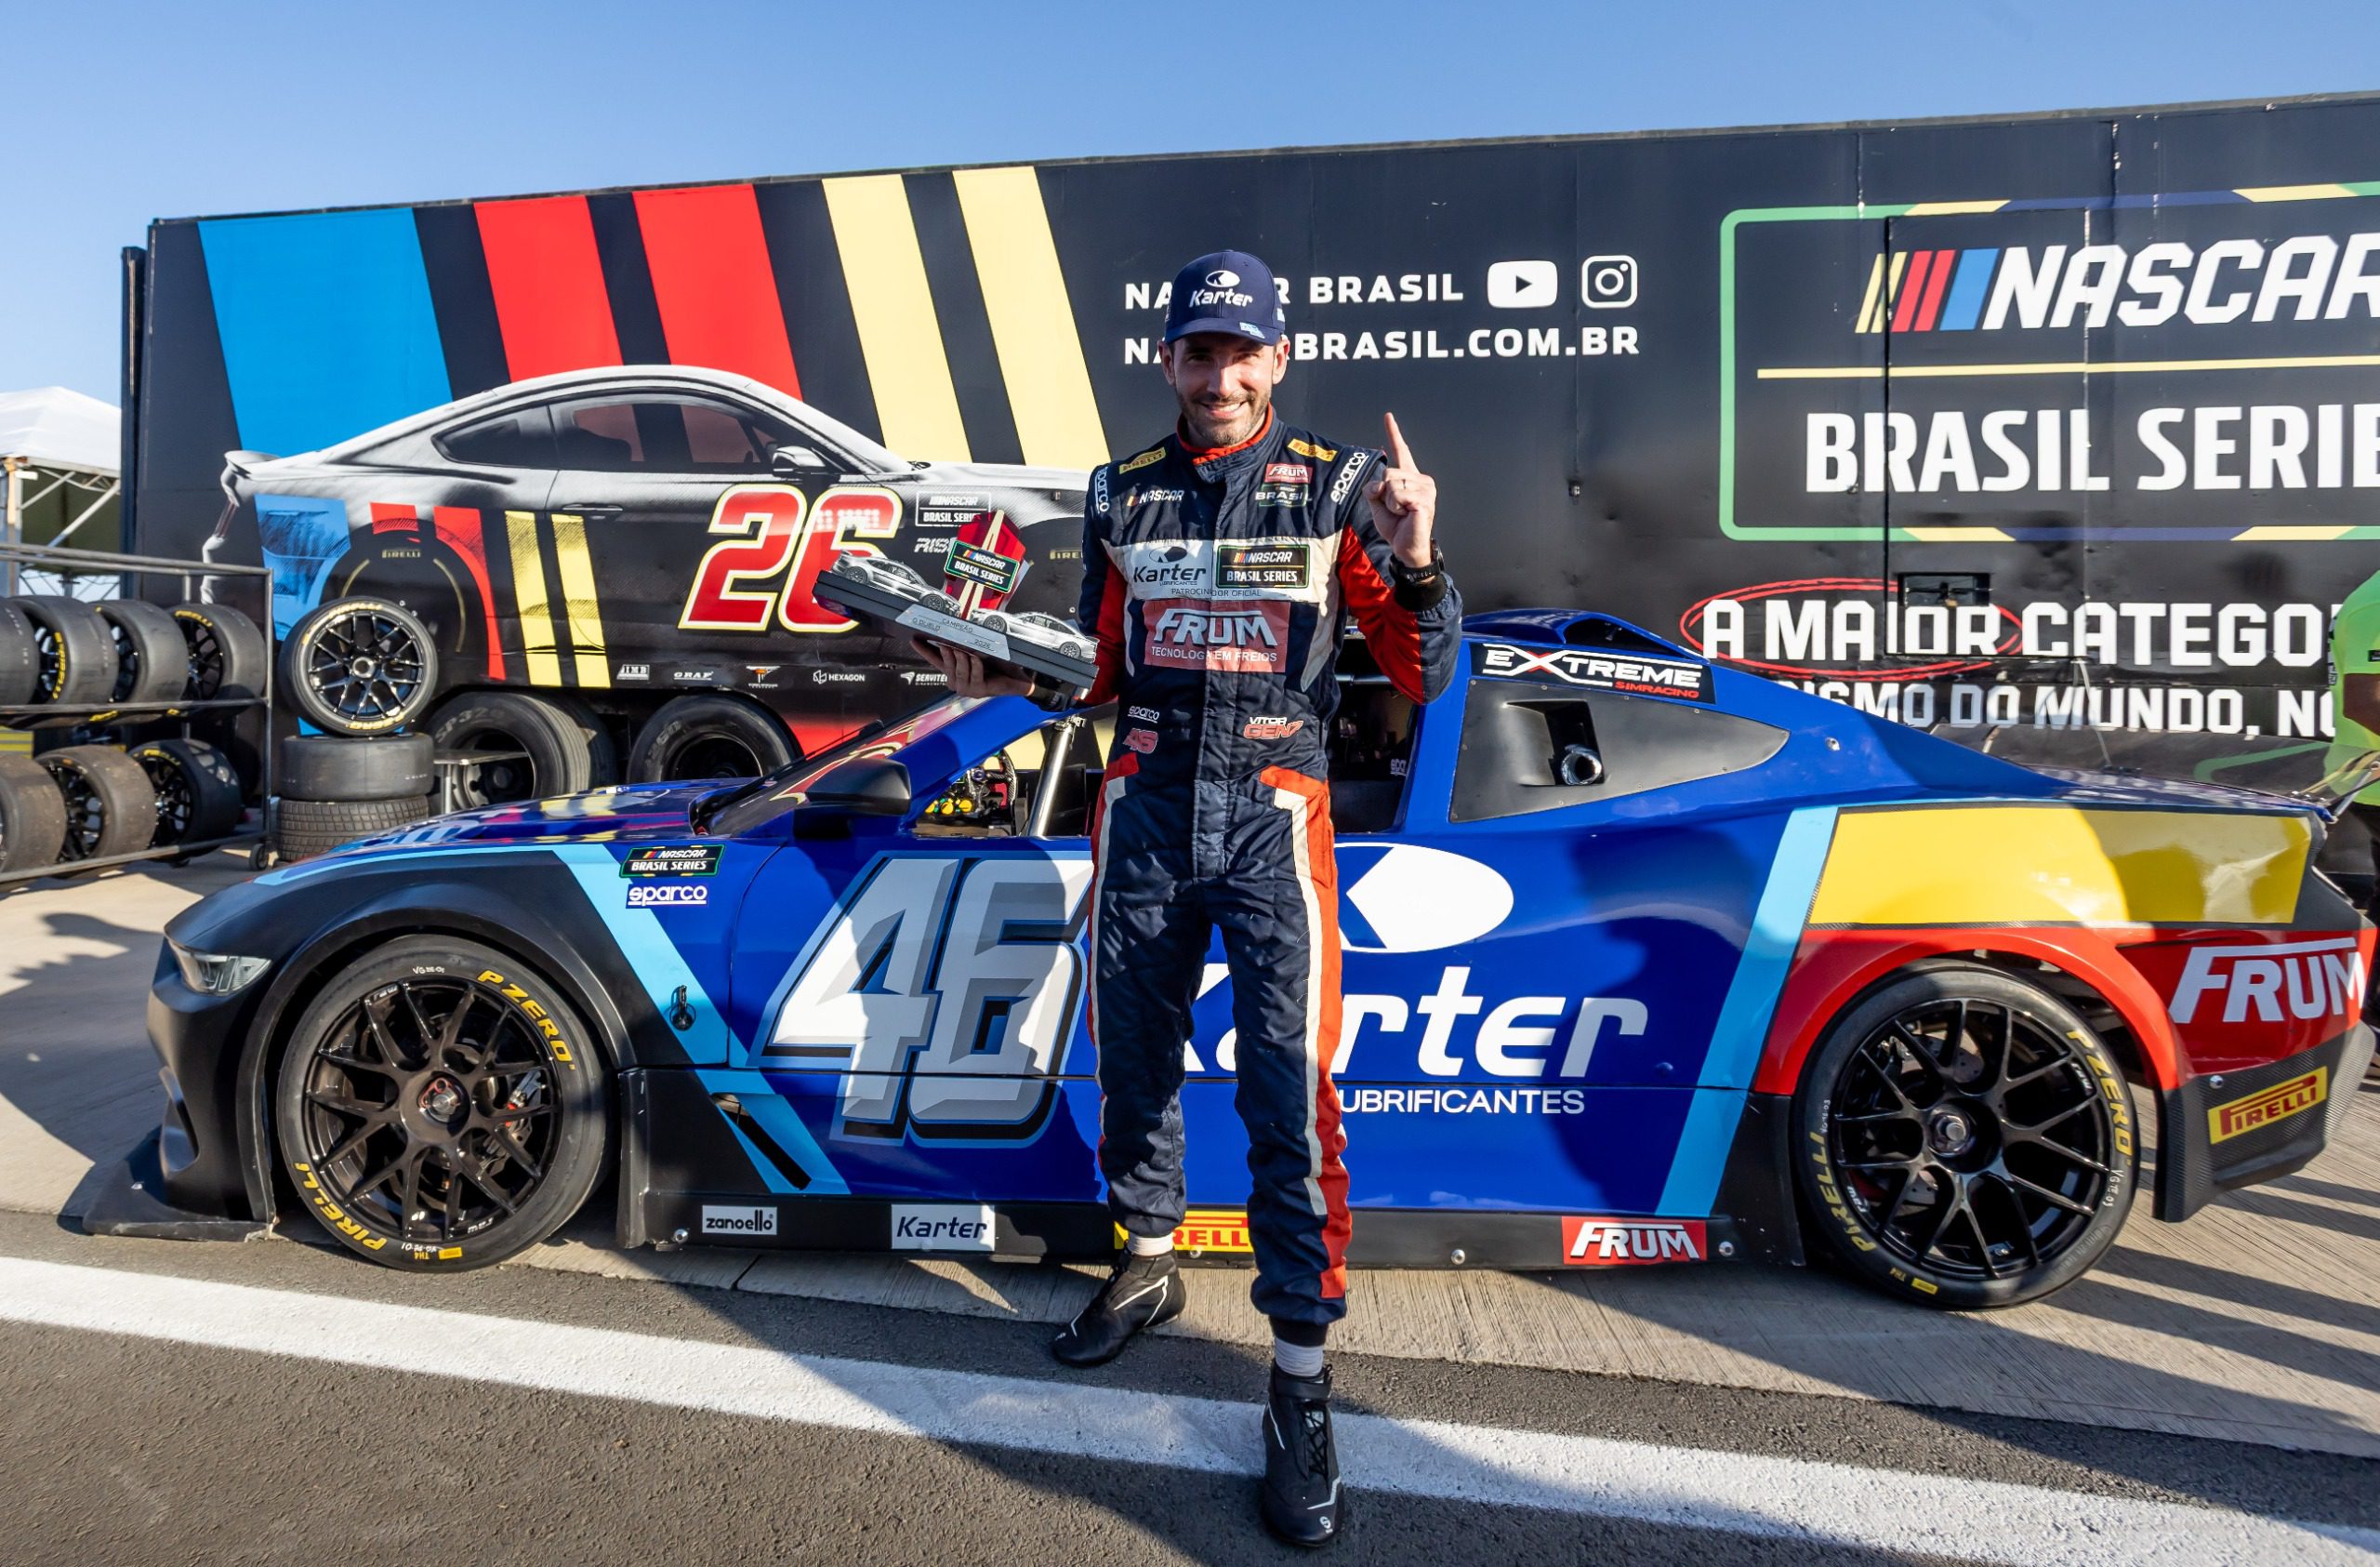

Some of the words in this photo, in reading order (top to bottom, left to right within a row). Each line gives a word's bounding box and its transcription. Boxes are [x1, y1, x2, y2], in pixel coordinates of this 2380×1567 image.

[1189, 288, 1253, 308] Karter
[1310, 272, 1463, 303] BRASIL
[1125, 325, 1640, 365] NBRASIL.COM.BR
[1806, 409, 2109, 493] BRASIL
[1269, 466, 1308, 476] FRUM
[1330, 452, 1368, 504] sparco
[1139, 490, 1184, 504] NASCAR
[1255, 491, 1313, 501] BRASIL
[923, 511, 952, 522] BRASIL
[678, 484, 903, 632] 26
[972, 551, 1006, 570] NASCAR
[1249, 551, 1292, 564] NASCAR
[954, 561, 979, 577] BRASIL
[980, 569, 1004, 585] SERIES
[1133, 564, 1207, 583] Karter
[1226, 570, 1262, 582] BRASIL
[1264, 570, 1298, 582] SERIES
[1171, 588, 1229, 597] PATROCINDOR
[1232, 589, 1261, 597] OFICIAL
[1154, 608, 1278, 647] FRUM
[1702, 600, 1744, 660] A
[1765, 599, 2001, 661] MAIOR
[2022, 602, 2344, 667] CATEGO
[1152, 646, 1211, 660] TECNOLOGA
[1214, 650, 1231, 661] EM
[1235, 650, 1276, 662] FREIOS
[1482, 643, 1703, 689] EXTREME
[828, 673, 866, 682] HEXAGON
[1615, 680, 1699, 698] SIMRACING
[1128, 706, 1159, 723] sparco
[1950, 684, 2020, 728] DO
[1250, 716, 1288, 725] VITOR
[657, 849, 707, 858] NASCAR
[631, 861, 668, 870] BRASIL
[670, 860, 707, 870] SERIES
[628, 885, 707, 906] sparco
[2168, 936, 2366, 1024] FRUM
[749, 850, 1094, 1147] 46
[1184, 963, 1648, 1078] rter
[1337, 1089, 1585, 1115] UBRIFICANTES
[2219, 1074, 2318, 1135] PIRELLI
[295, 1162, 388, 1251] PIRELLI
[896, 1216, 988, 1239] Karter
[1570, 1221, 1700, 1260] FRUM
